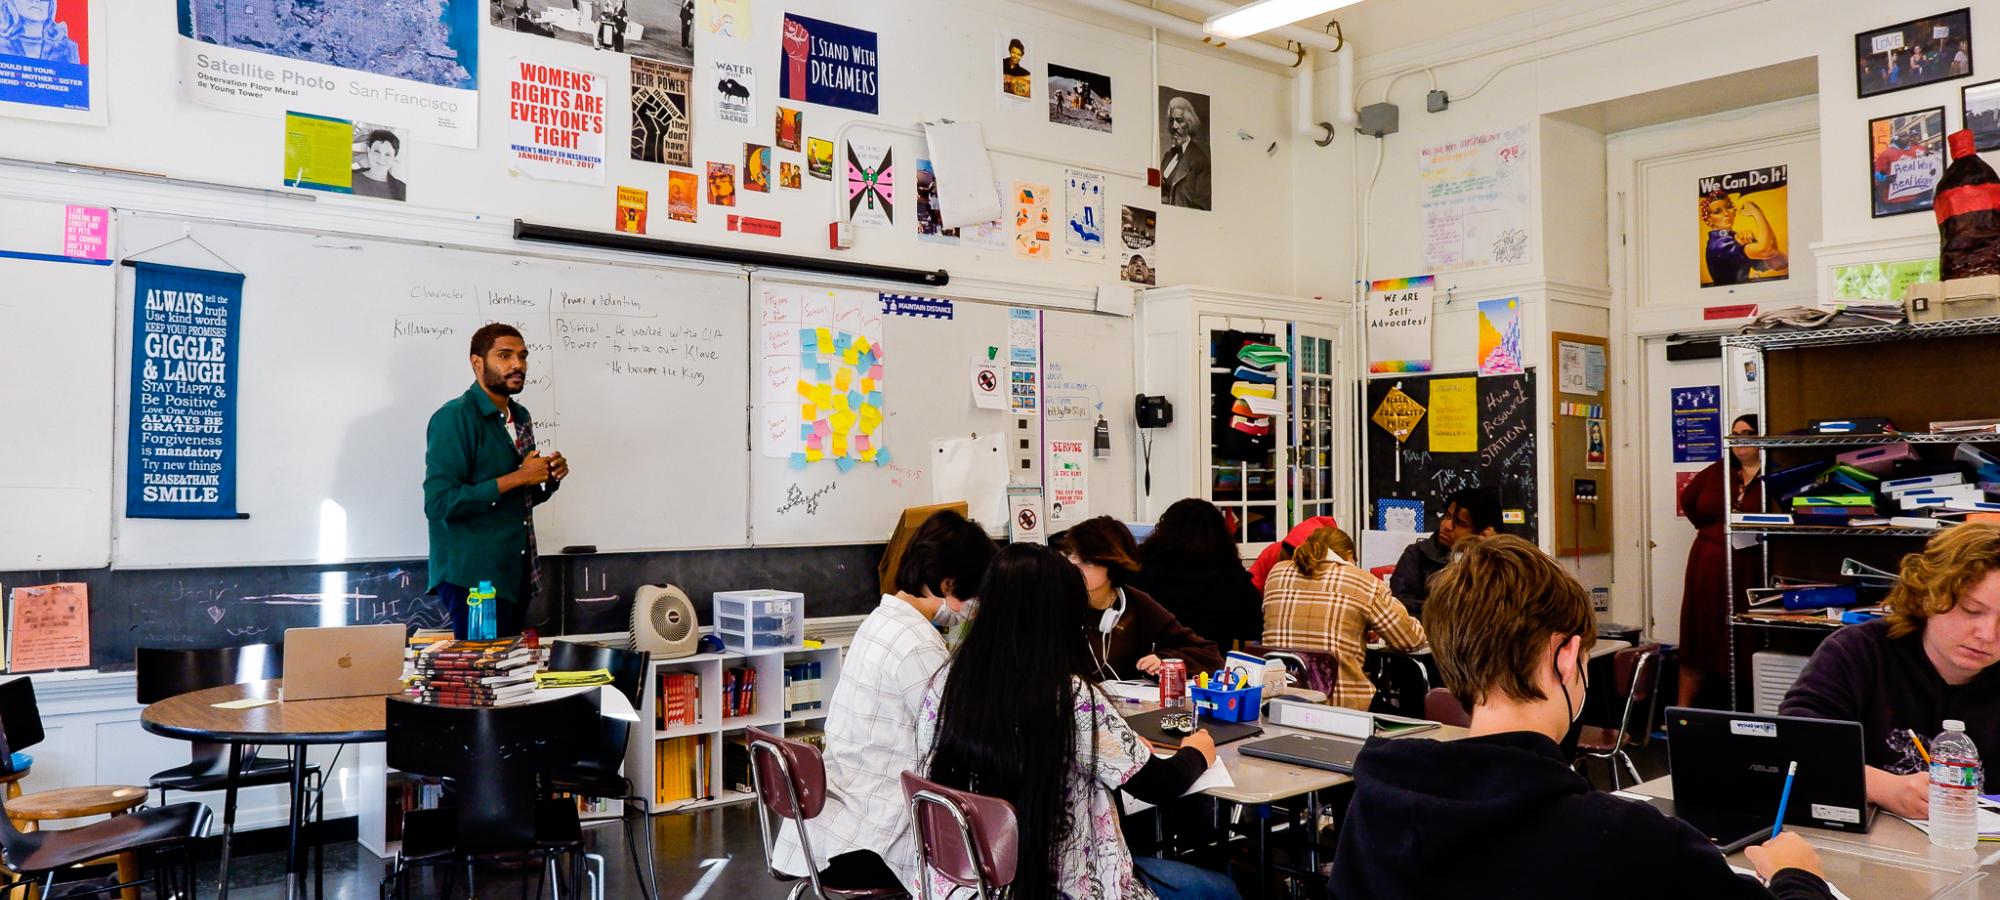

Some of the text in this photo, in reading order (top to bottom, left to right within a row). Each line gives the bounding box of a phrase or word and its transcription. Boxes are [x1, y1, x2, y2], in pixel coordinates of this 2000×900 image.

[810, 36, 876, 67] I STAND WITH
[33, 66, 57, 76] YOUR:
[716, 61, 752, 75] WATER
[22, 73, 53, 83] MOTHER
[59, 78, 83, 87] SISTER
[197, 54, 458, 113] Satellite Photo San Francisco
[197, 72, 299, 96] Observation Floor Mural
[520, 62, 595, 93] WOMENS'
[632, 71, 686, 94] THEIR POWER
[811, 60, 876, 96] DREAMERS
[25, 81, 70, 92] CO-WORKER
[210, 83, 236, 95] Young
[239, 89, 263, 99] Tower
[511, 81, 604, 115] RIGHTS ARE
[653, 89, 679, 117] thinking
[511, 101, 603, 134] EVERYONE'S
[671, 120, 688, 131] they
[534, 126, 580, 150] FIGHT
[668, 131, 688, 141] don't
[665, 140, 685, 151] have
[518, 152, 554, 163] JANUARY
[577, 160, 595, 169] 2017
[538, 147, 557, 157] MARCH
[566, 152, 601, 164] WASHINGTON
[1700, 165, 1786, 194] We Can Do It!
[145, 289, 228, 314] ALWAYS tell the
[410, 286, 464, 300] Character
[489, 290, 536, 307] Identities
[561, 292, 586, 309] Power
[1384, 292, 1418, 302] WE ARE
[205, 307, 228, 317] truth
[898, 303, 952, 314] MAINTAIN DISTANCE
[1389, 307, 1412, 316] Self-
[146, 310, 227, 327] Use kind words
[1371, 316, 1427, 328] Advocates!
[145, 322, 227, 338] KEEP YOUR PROMISES
[556, 318, 600, 337] Political
[145, 333, 225, 362] GIGGLE
[563, 335, 597, 351] Power
[143, 358, 226, 384] & LAUGH
[214, 385, 226, 399] &
[141, 393, 218, 408] Be Positive
[142, 405, 223, 417] Love One Another
[142, 414, 224, 426] ALWAYS BE
[141, 423, 223, 434] GRATEFUL
[142, 433, 223, 447] Forgiveness
[1480, 420, 1527, 467] STATION
[141, 444, 223, 460] is mandatory
[142, 458, 222, 474] Try new things
[143, 486, 219, 503] SMILE
